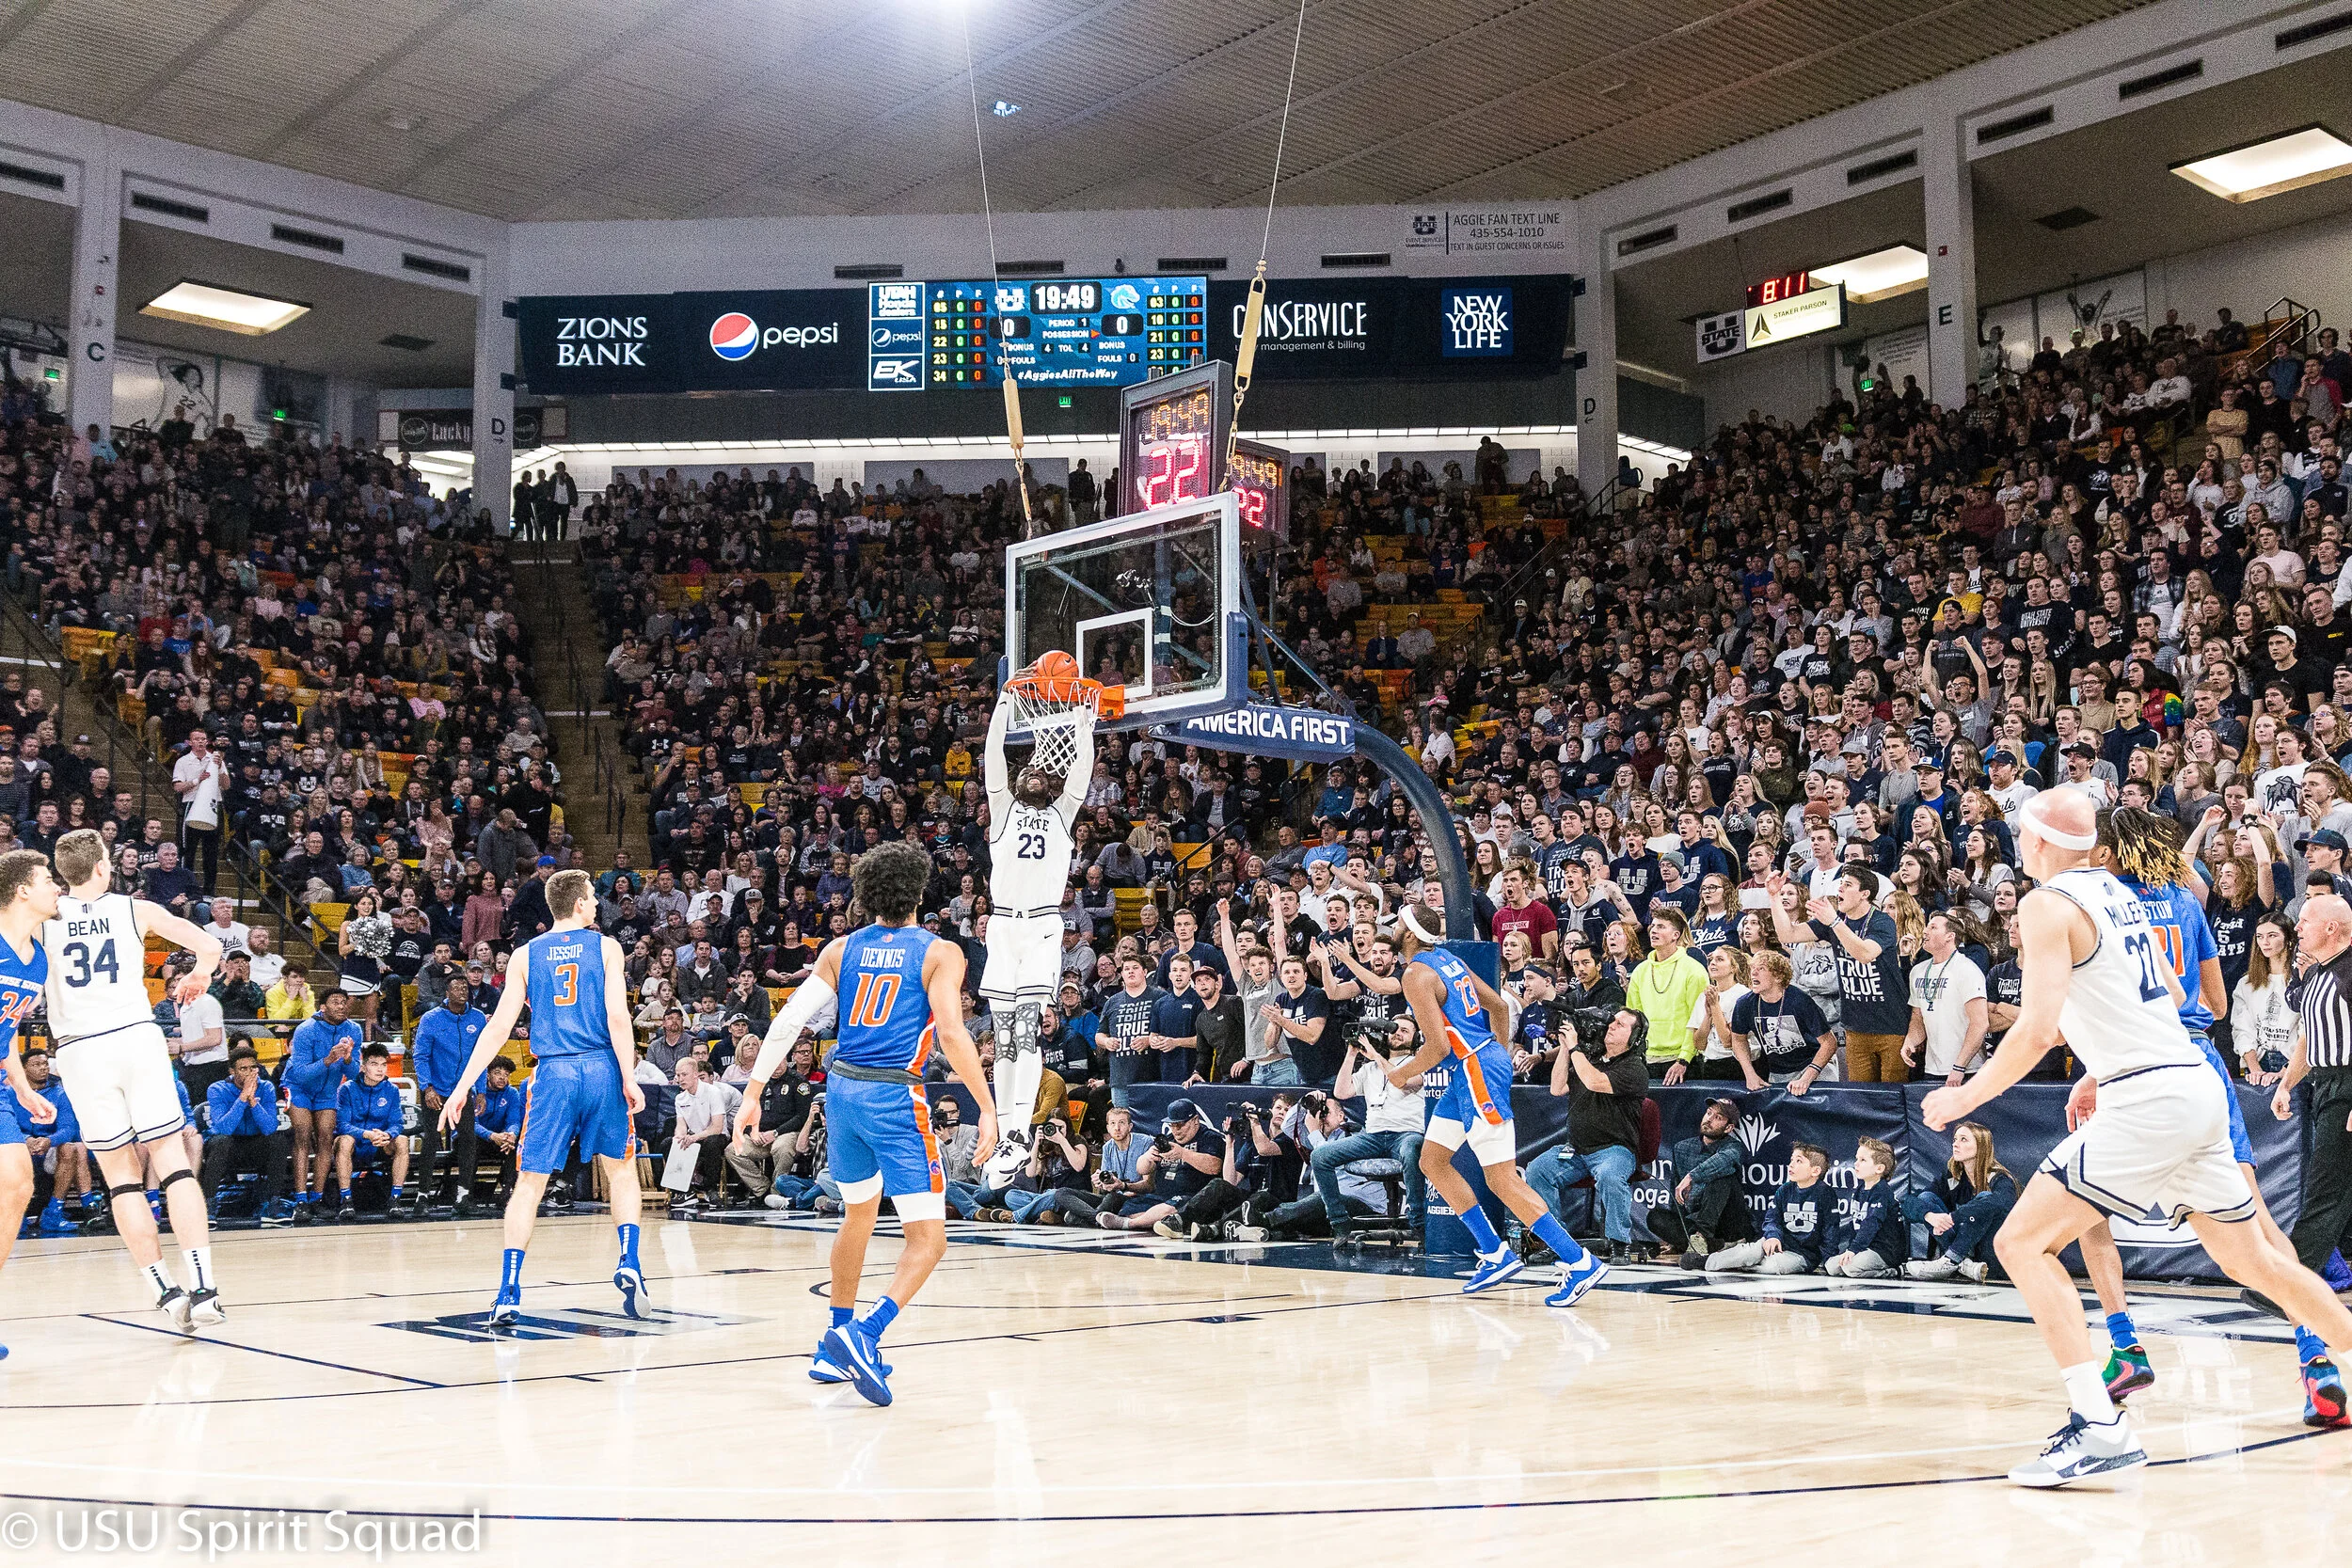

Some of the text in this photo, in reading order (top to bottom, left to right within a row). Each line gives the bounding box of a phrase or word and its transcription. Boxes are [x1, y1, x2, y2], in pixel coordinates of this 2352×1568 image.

[1453, 213, 1560, 226] AGGIE FAN TEXT LINE
[1470, 227, 1544, 238] 435-554-1010
[1450, 243, 1464, 251] TEXT
[1466, 243, 1473, 251] IN
[1475, 242, 1496, 251] GUEST
[1497, 242, 1532, 250] CONCERNS
[1533, 242, 1542, 250] OR
[1543, 241, 1565, 249] ISSUES
[956, 301, 964, 313] 0
[974, 300, 982, 312] 0
[1035, 284, 1095, 310] 19:49
[1171, 296, 1180, 309] 0
[1190, 295, 1200, 308] 0
[1453, 294, 1503, 313] NEW
[1171, 313, 1180, 325] 0
[1190, 312, 1200, 325] 0
[1773, 307, 1799, 320] STAKER
[1800, 299, 1827, 312] PARSON
[1938, 304, 1953, 326] E
[557, 316, 649, 341] ZIONS
[956, 319, 964, 330] 0
[974, 318, 982, 329] 0
[1003, 318, 1015, 337] 0
[1048, 318, 1087, 327] PERIOD 1
[1116, 315, 1129, 335] 0
[1232, 300, 1367, 340] CNSERVICE
[1445, 311, 1509, 332] YORK
[762, 322, 839, 350] pepsi
[892, 331, 922, 342] pepsi
[933, 335, 982, 347] 22 0 0
[1042, 329, 1089, 339] POSSESSION
[1150, 330, 1200, 342] 21 0 0
[1454, 329, 1502, 349] LIFE
[1701, 325, 1740, 346] STATE
[87, 341, 105, 362] C
[557, 342, 646, 367] BANK
[1007, 342, 1089, 353] BONUS 4 TOL 4
[1098, 341, 1126, 350] BONUS
[1150, 348, 1165, 359] 23
[1171, 348, 1180, 359] 0
[1261, 341, 1325, 352] management
[1327, 340, 1335, 350] &
[1337, 340, 1366, 351] billing
[933, 352, 982, 365] 23 0 0
[1010, 356, 1036, 365] FOULS
[1097, 353, 1136, 363] FOULS 0
[873, 359, 920, 379] EK
[933, 369, 982, 382] 34 0 0
[1017, 368, 1118, 381] #AggiesAllTheWay
[1583, 397, 1597, 415] D
[1151, 391, 1210, 441] 19:49
[491, 417, 505, 436] D
[1145, 438, 1200, 511] 22
[1186, 709, 1351, 746] AMERICA FIRST
[1016, 815, 1050, 832] STATE
[1017, 833, 1046, 860] 23
[2104, 899, 2143, 928] MILLER
[68, 917, 110, 937] BEAN
[1692, 926, 1727, 946] State
[546, 943, 583, 961] JESSUP
[859, 946, 906, 969] DENNIS
[62, 938, 120, 989] 34
[1836, 957, 1881, 978] TRUE
[2124, 932, 2169, 1004] 22
[553, 962, 580, 1006] 3
[1841, 975, 1883, 996] BLUE
[848, 972, 903, 1028] 10
[1453, 974, 1481, 1018] 23
[1844, 993, 1885, 1003] AGGIES
[0, 990, 33, 1028] 34
[1115, 1020, 1151, 1037] TRUE
[1045, 1049, 1065, 1064] GGIES
[1765, 1040, 1806, 1054] AGGIES
[721, 1055, 735, 1067] UTA
[1426, 1205, 1455, 1216] AGGIES
[1783, 1211, 1819, 1224] STATE
